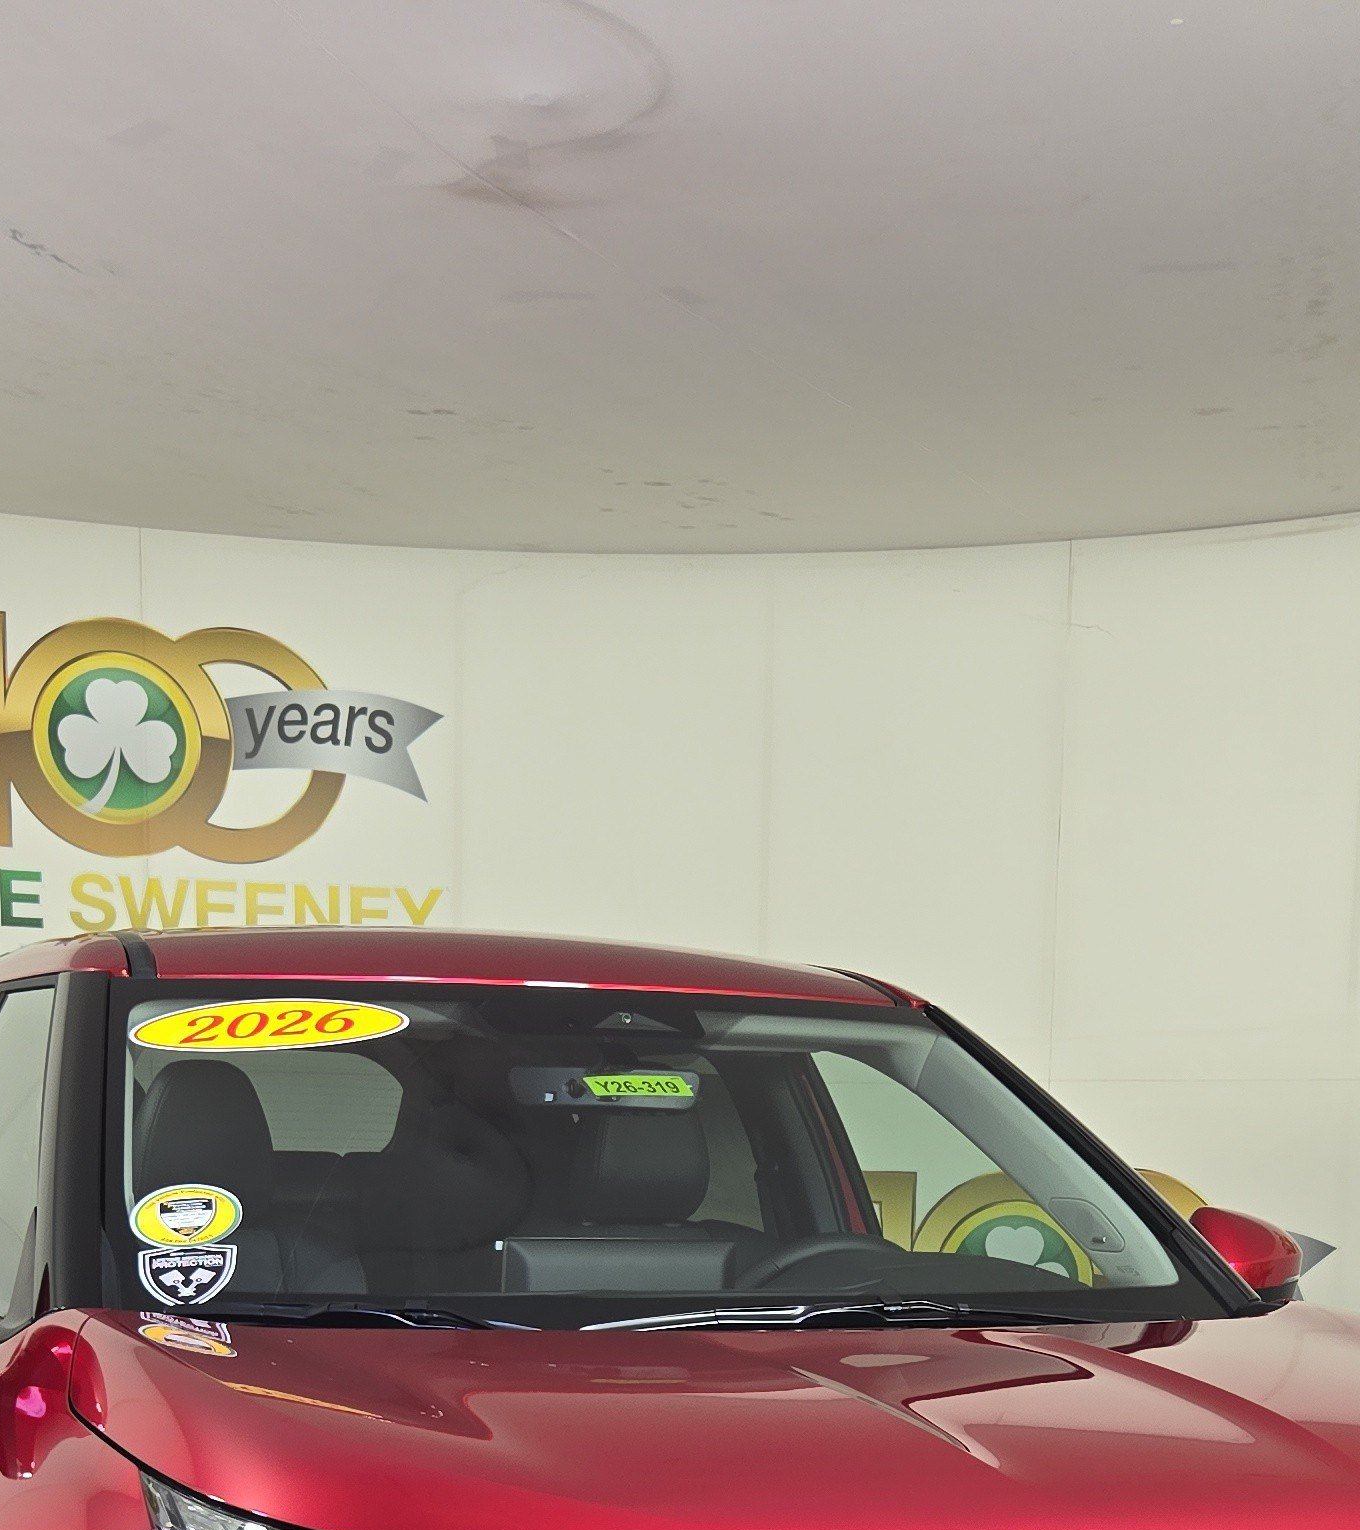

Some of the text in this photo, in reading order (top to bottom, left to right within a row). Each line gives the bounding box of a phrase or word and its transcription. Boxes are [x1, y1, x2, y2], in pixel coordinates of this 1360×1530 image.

[244, 702, 395, 759] years
[181, 1008, 359, 1044] 2026
[594, 1080, 680, 1093] Y26-319
